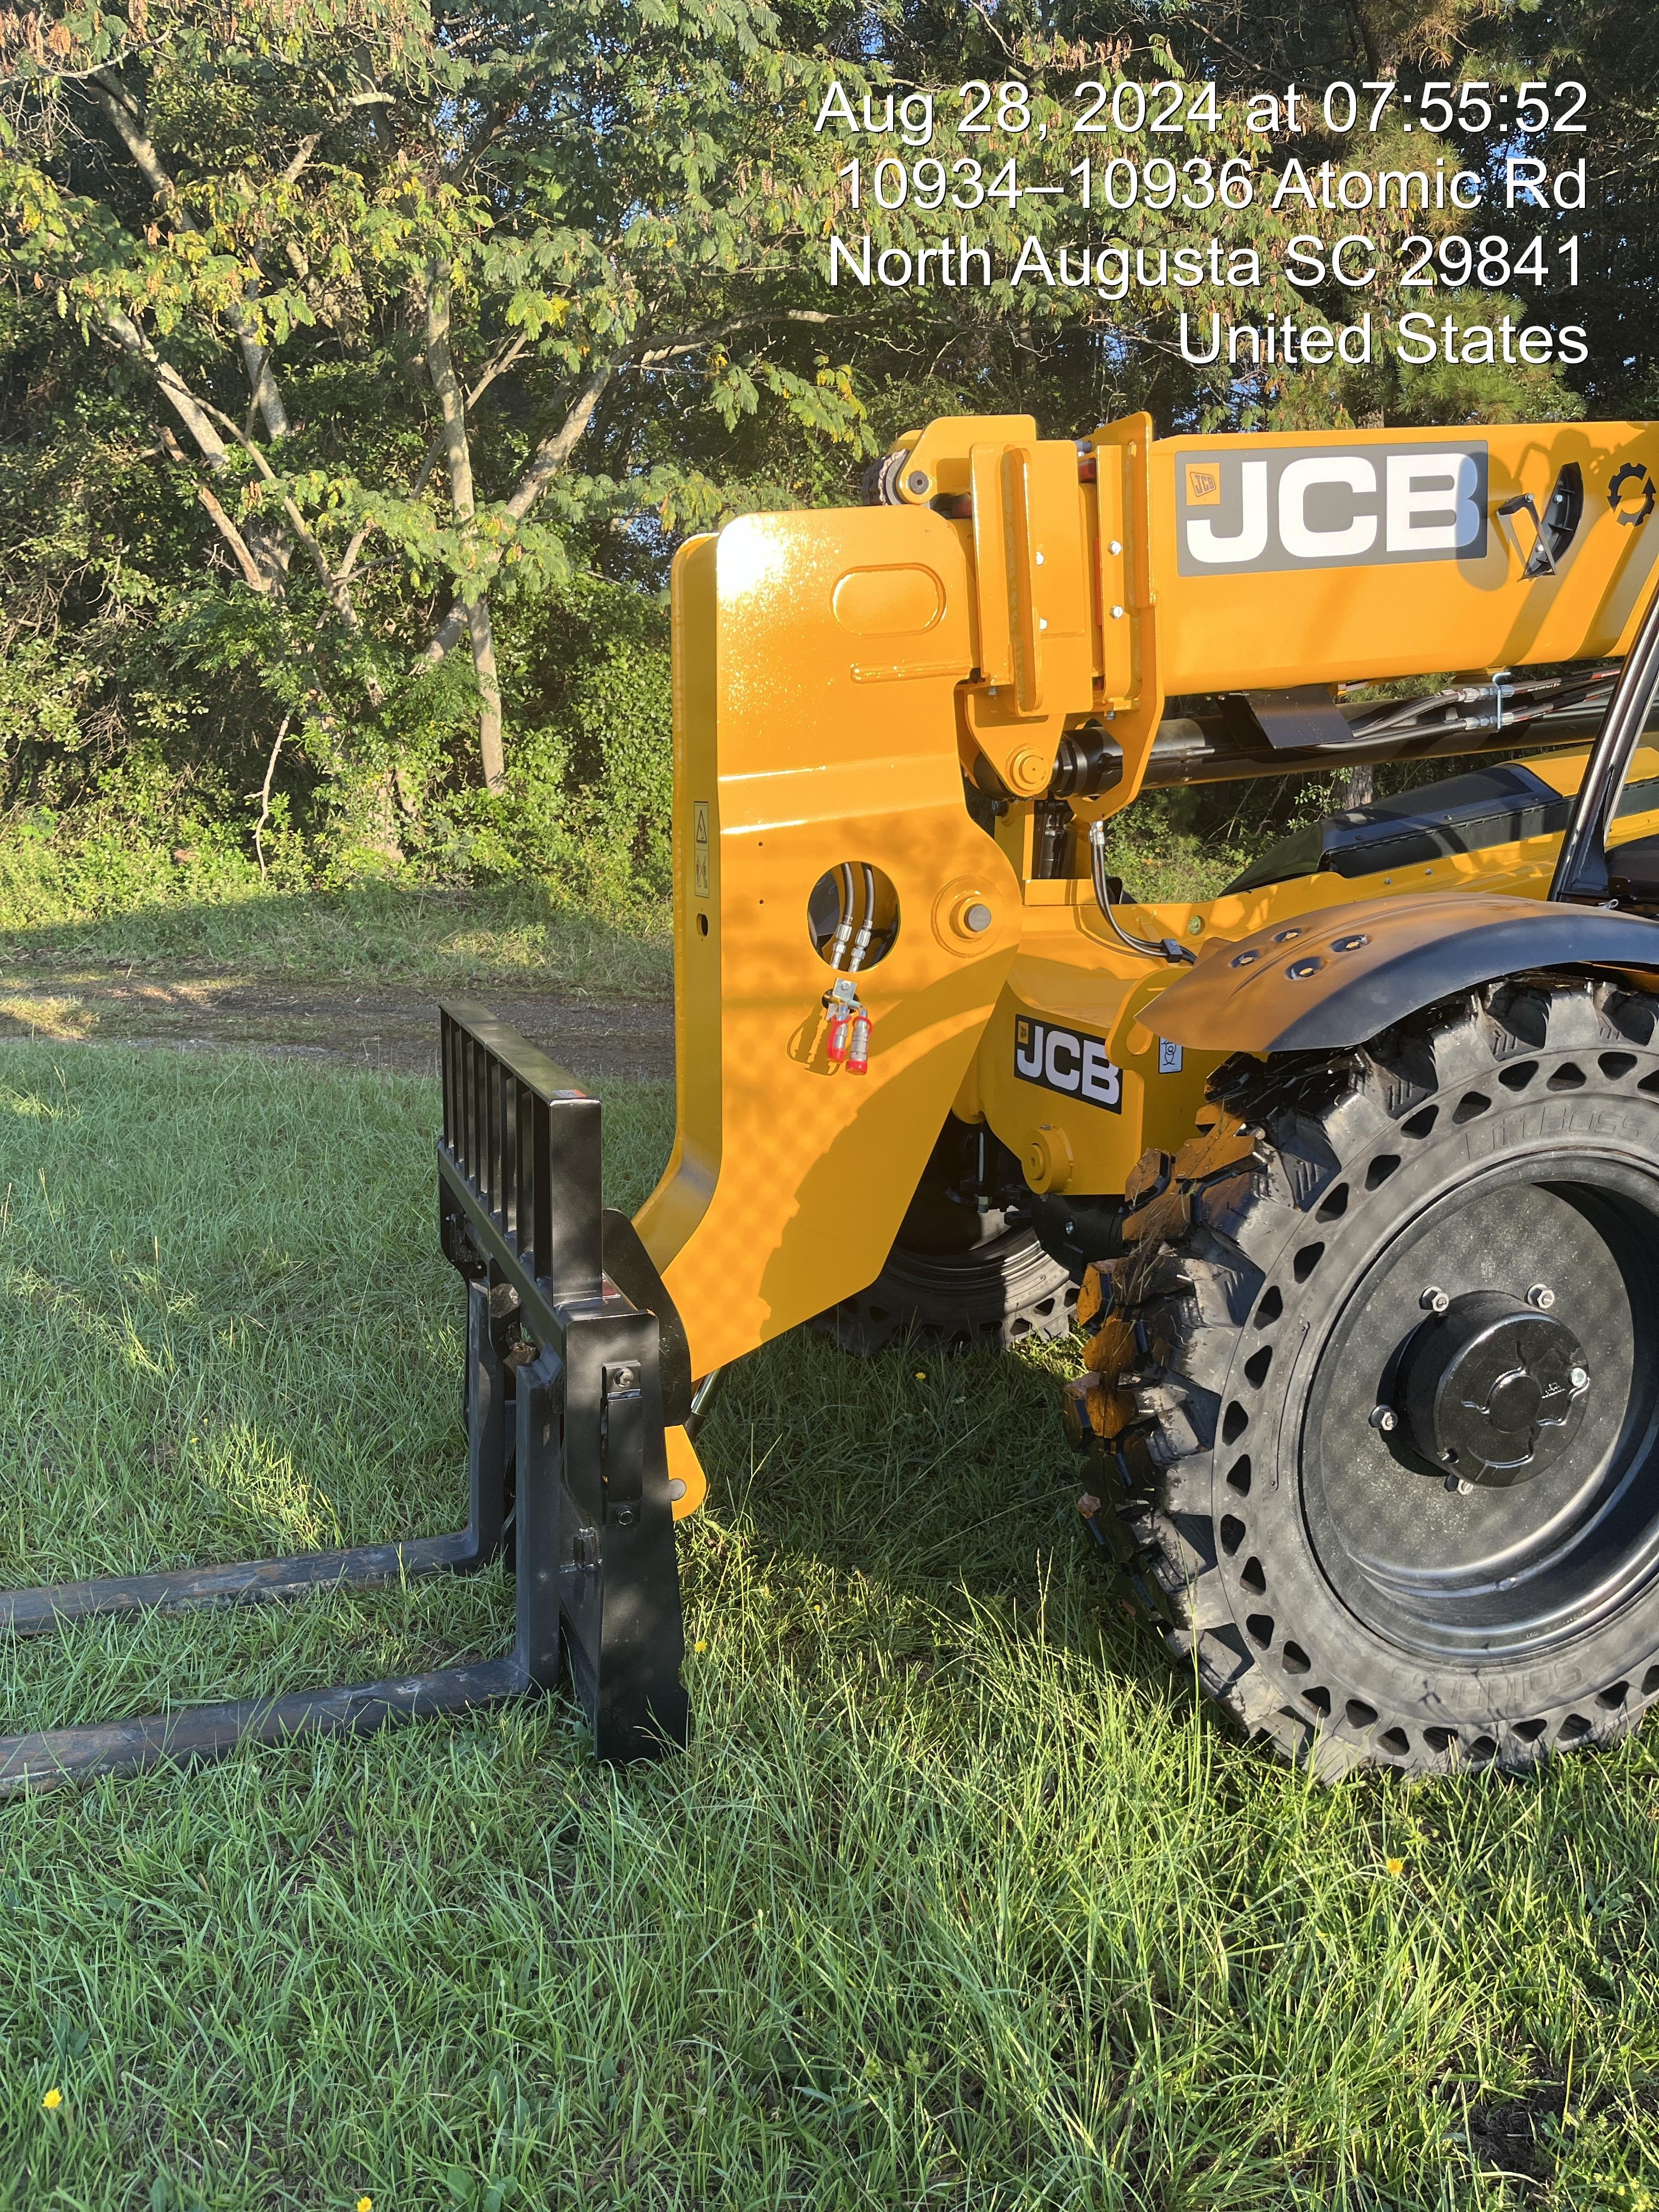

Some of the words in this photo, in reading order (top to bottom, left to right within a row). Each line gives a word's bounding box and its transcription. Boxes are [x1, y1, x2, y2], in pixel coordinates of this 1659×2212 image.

[1186, 453, 1480, 564] JCB
[1194, 474, 1215, 494] JCB
[1017, 1025, 1120, 1104] JCB
